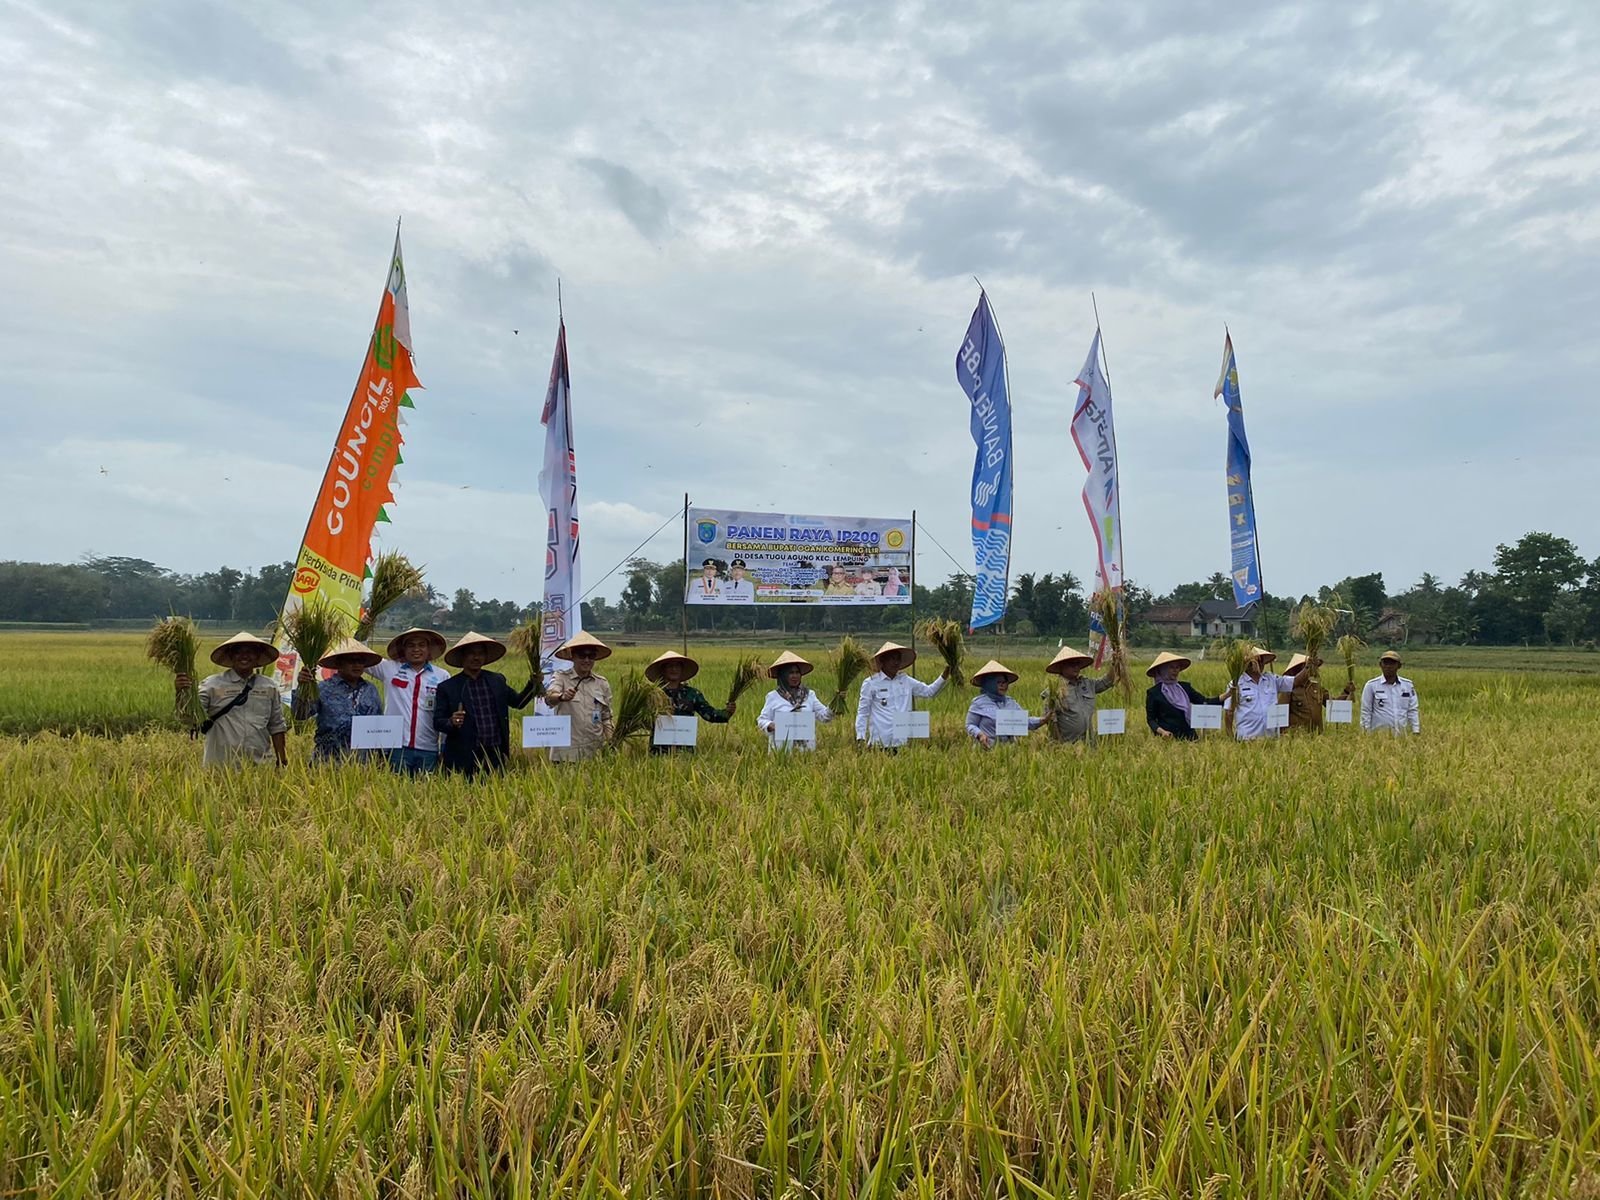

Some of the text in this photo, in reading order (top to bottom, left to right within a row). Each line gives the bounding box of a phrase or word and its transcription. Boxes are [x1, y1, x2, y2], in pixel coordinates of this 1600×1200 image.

[378, 396, 391, 413] 300
[727, 525, 880, 544] PANEN RAYA IP200
[726, 542, 767, 551] BERSAMA
[768, 544, 796, 552] BUPATI
[797, 544, 821, 552] OGAN
[822, 546, 864, 554] KOMERING
